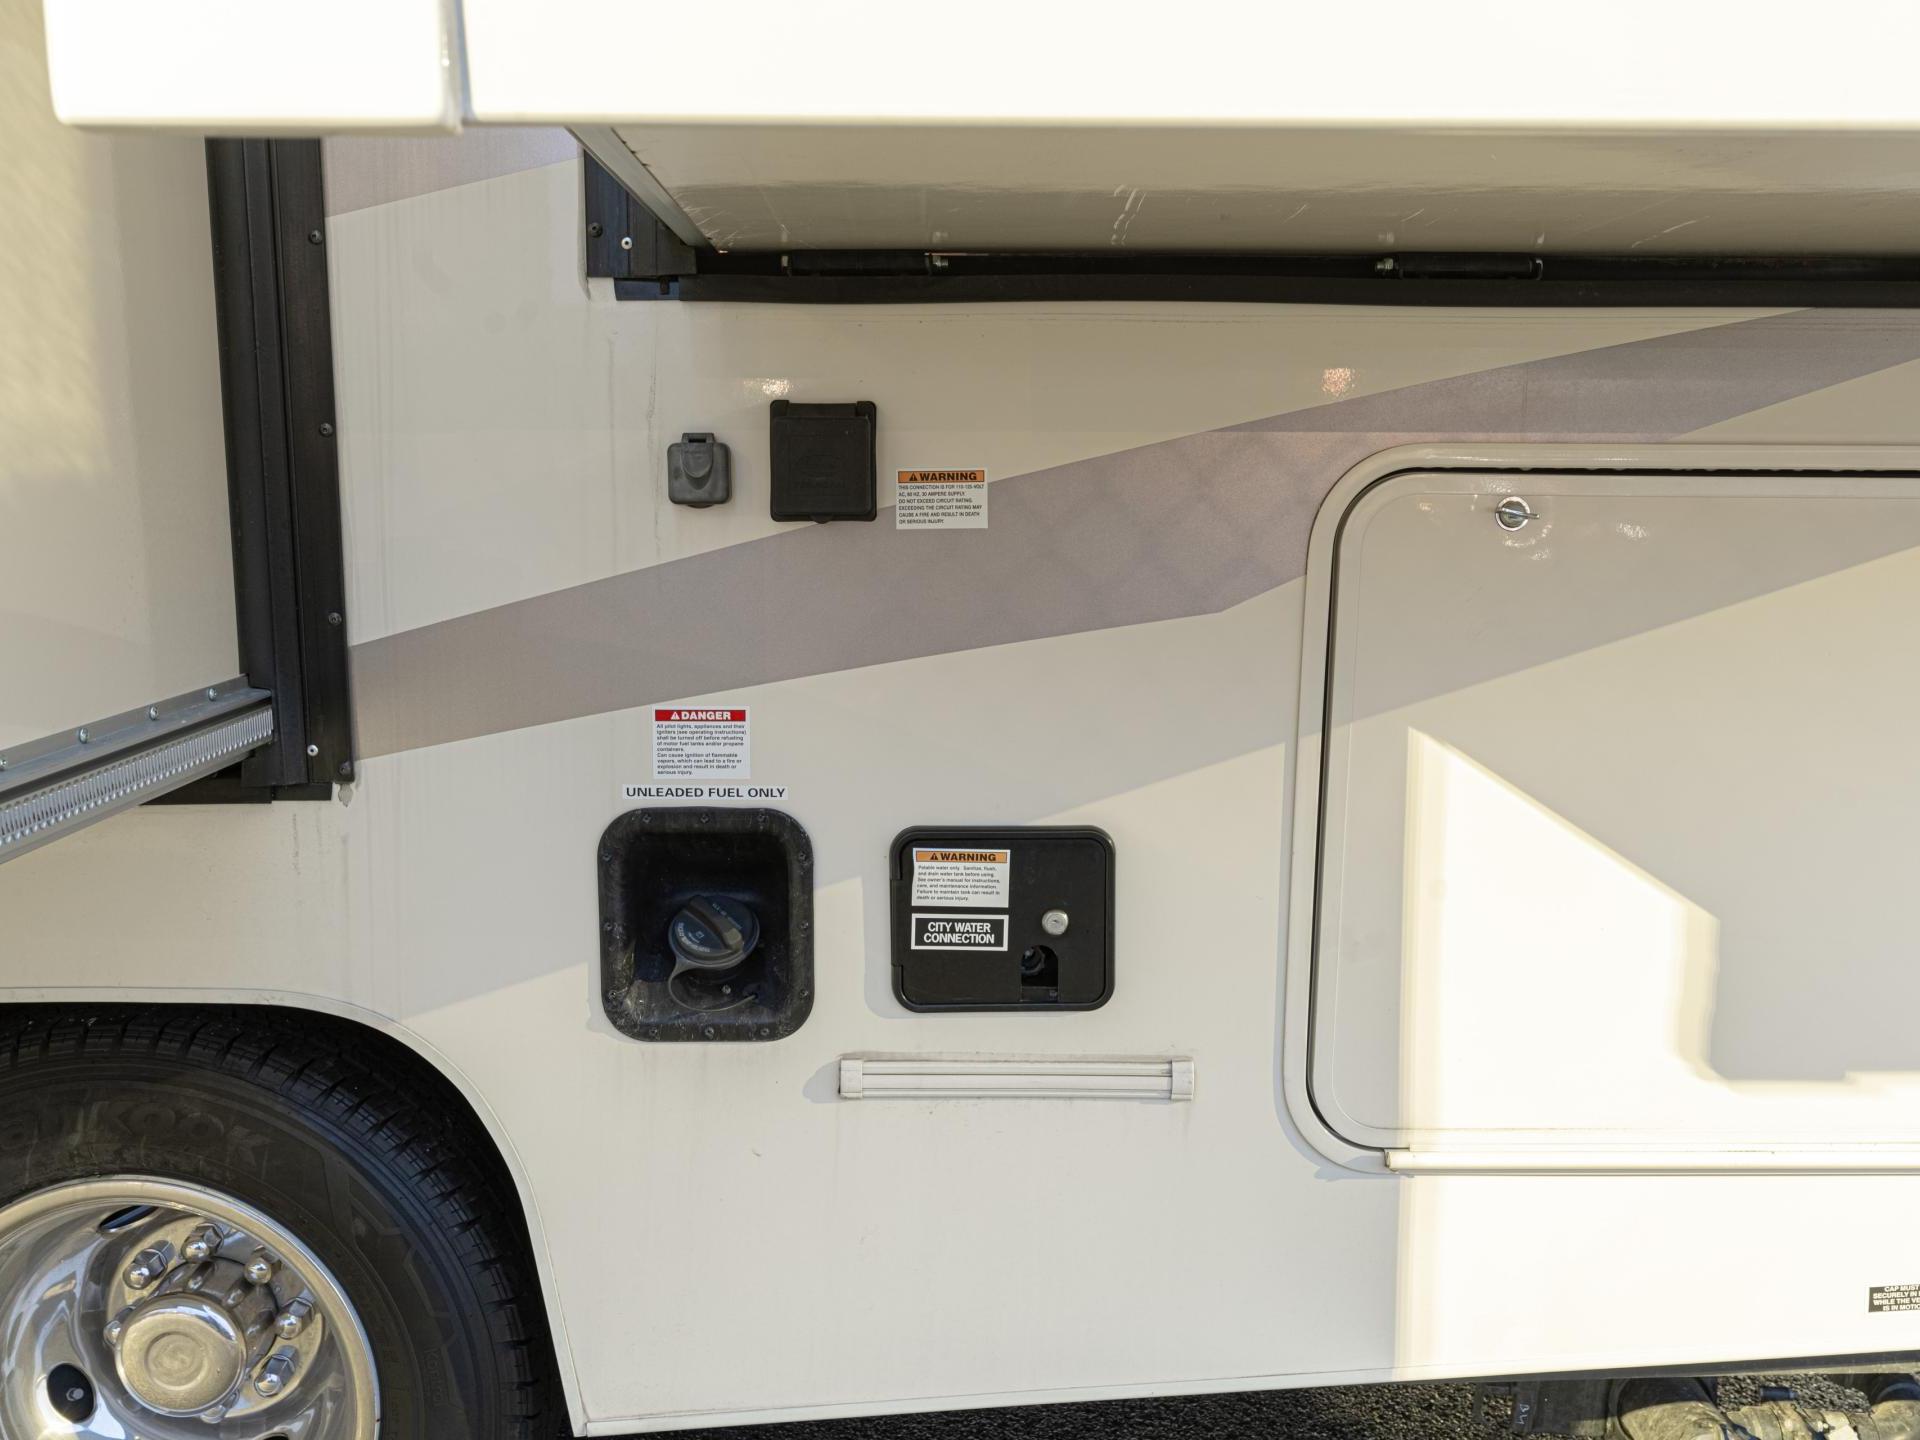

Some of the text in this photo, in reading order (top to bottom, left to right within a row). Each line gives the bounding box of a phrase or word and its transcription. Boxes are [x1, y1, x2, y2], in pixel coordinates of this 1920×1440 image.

[919, 472, 977, 481] WARNING
[681, 711, 731, 720] DANGER
[626, 787, 786, 798] UNLEADED FUEL ONLY
[941, 853, 996, 862] WARNING
[928, 922, 991, 932] CITY WATER
[924, 933, 994, 944] CONNECTION
